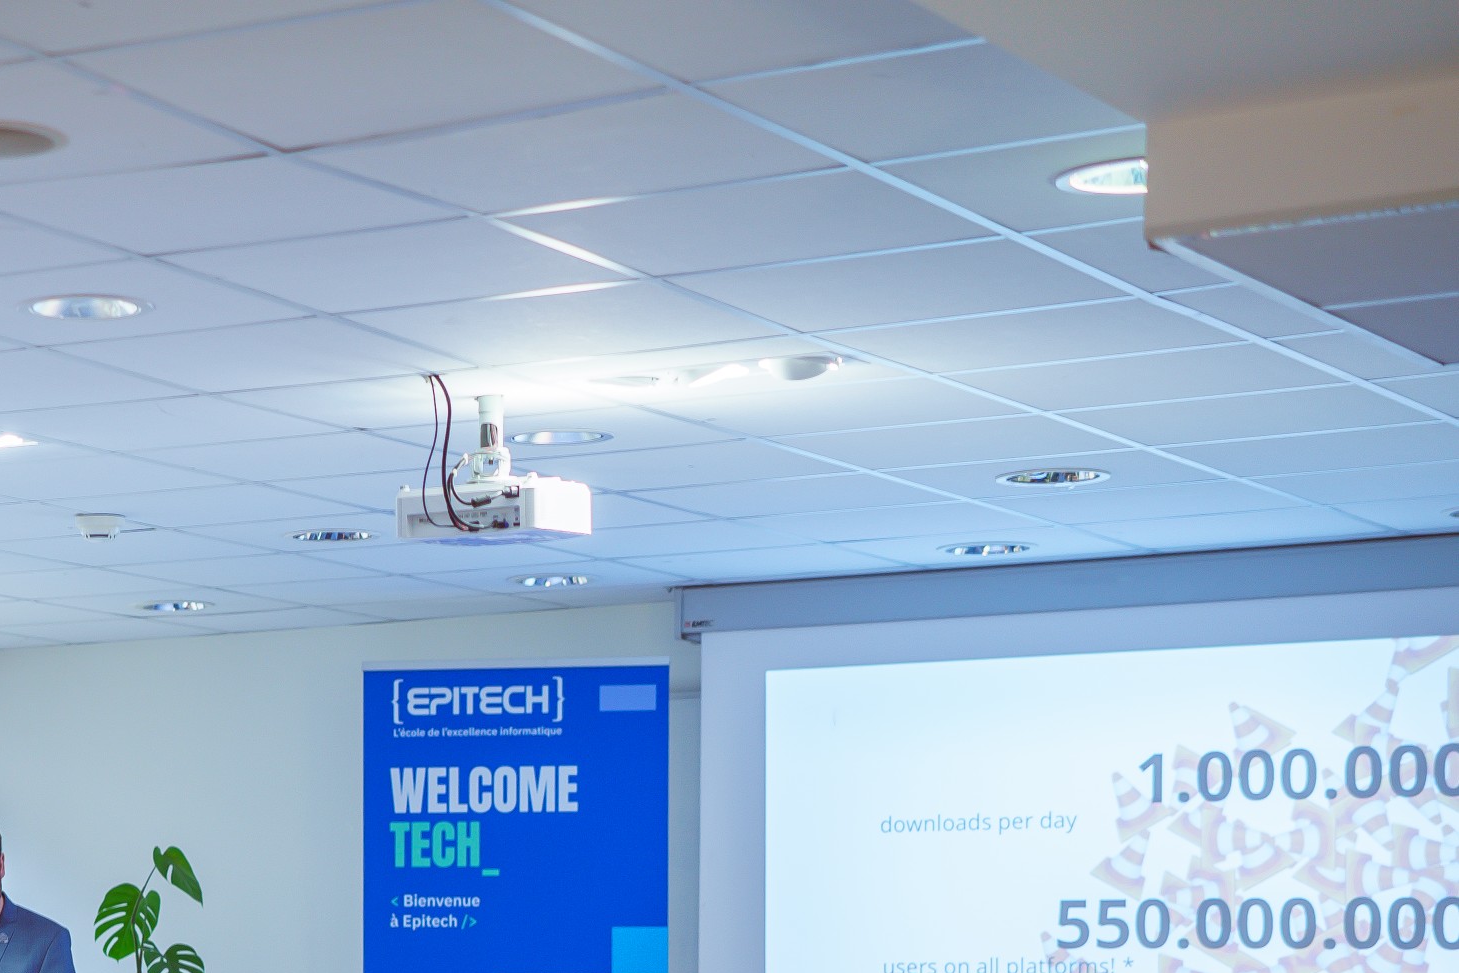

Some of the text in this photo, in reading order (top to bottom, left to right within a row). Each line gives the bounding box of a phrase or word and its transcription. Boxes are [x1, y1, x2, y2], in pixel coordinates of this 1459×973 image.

[427, 727, 440, 738] de
[442, 726, 498, 738] l'excellence
[499, 726, 563, 738] informatique
[390, 765, 579, 814] WELCOME
[880, 810, 1078, 835] downloads per day
[403, 893, 481, 908] Bienvenue
[389, 912, 399, 928] à
[403, 913, 458, 931] Epitech
